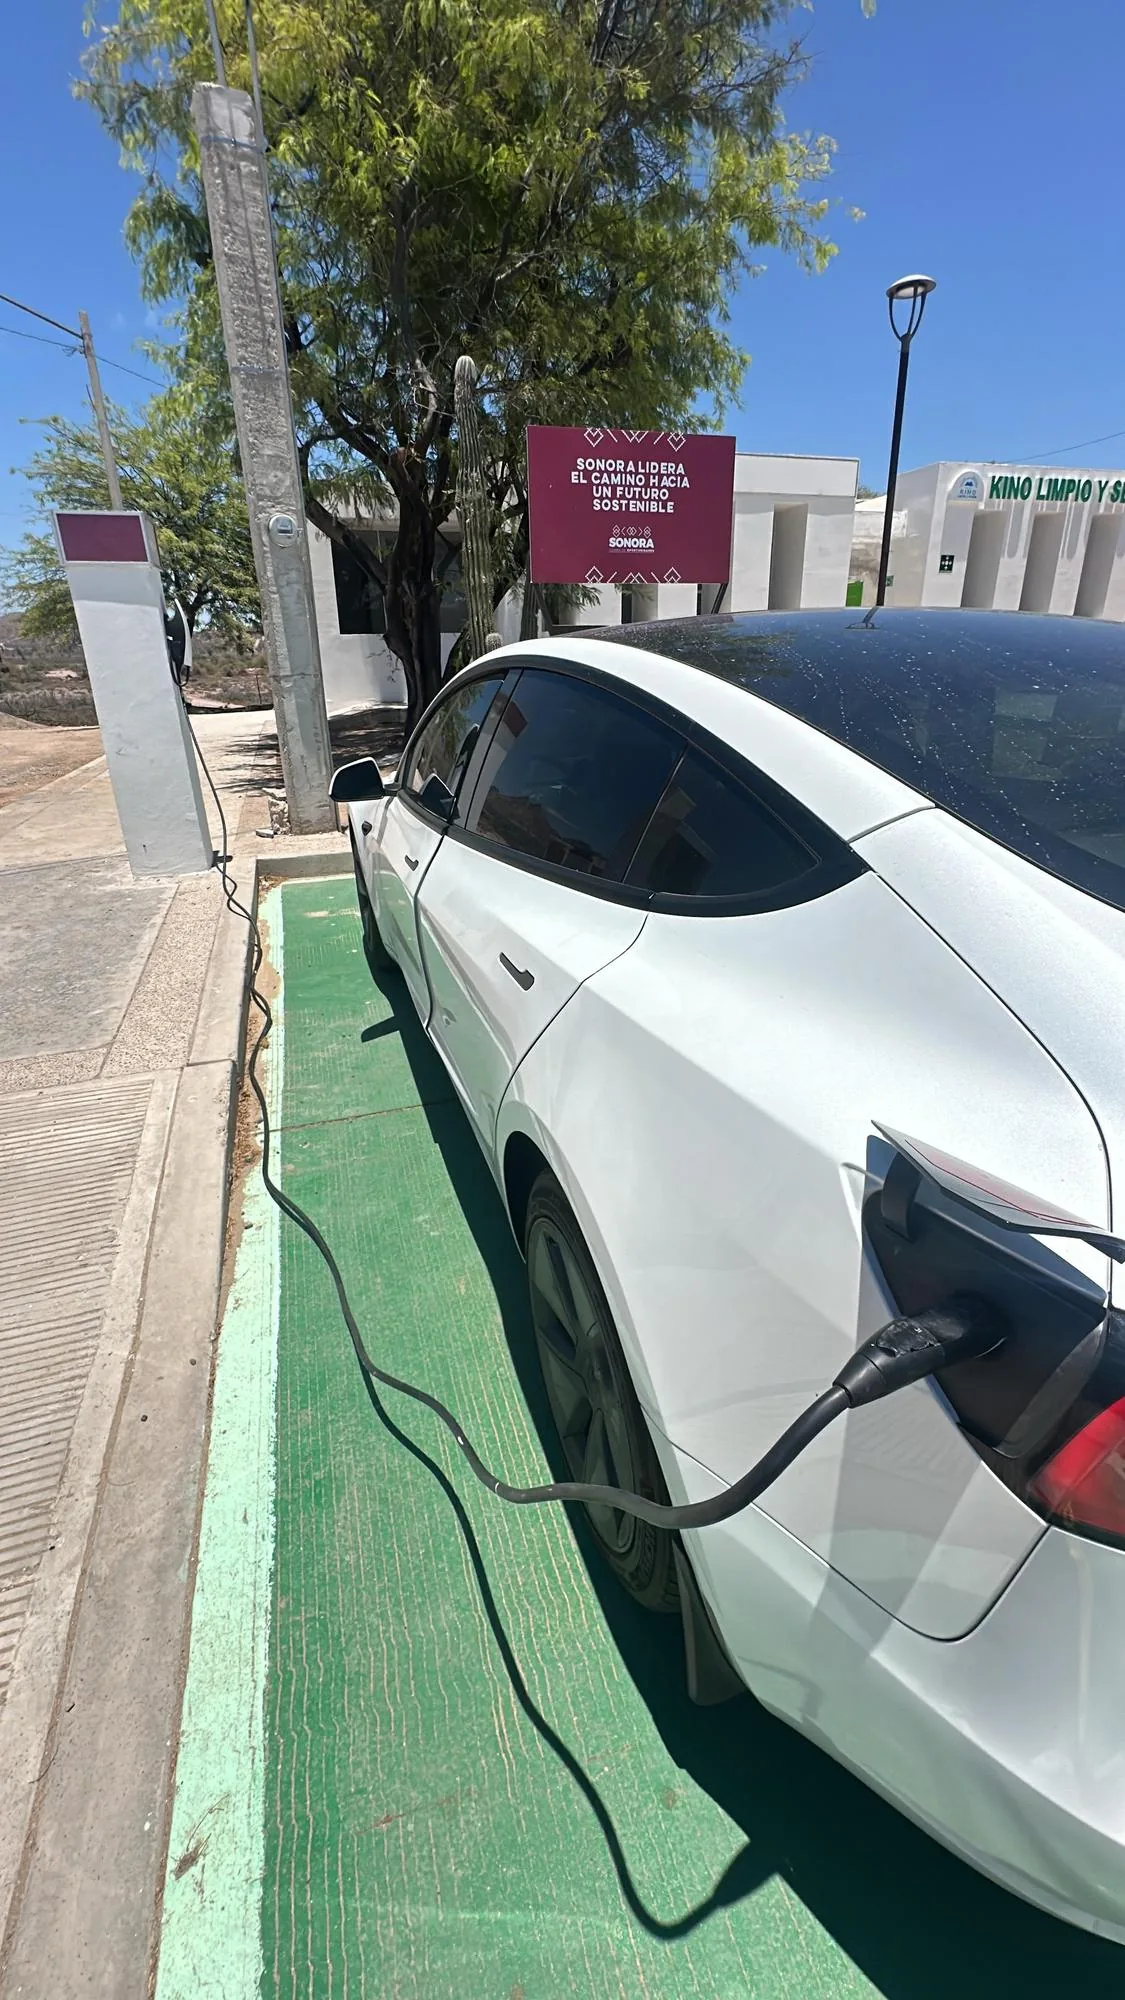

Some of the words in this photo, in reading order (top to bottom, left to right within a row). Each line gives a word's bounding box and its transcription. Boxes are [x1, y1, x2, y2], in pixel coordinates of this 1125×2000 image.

[577, 458, 635, 472] SONORA
[638, 461, 685, 475] LIDERA
[571, 472, 587, 483] EL
[591, 472, 645, 486] CAMINO
[650, 475, 690, 488] HACIA
[593, 487, 611, 498] UN
[616, 487, 669, 500] FUTURO
[989, 475, 1033, 501] KINO
[1036, 477, 1092, 503] LIMPIO
[1097, 479, 1109, 503] Y
[593, 499, 674, 513] SOSTENIBLE
[609, 537, 654, 548] SONORA
